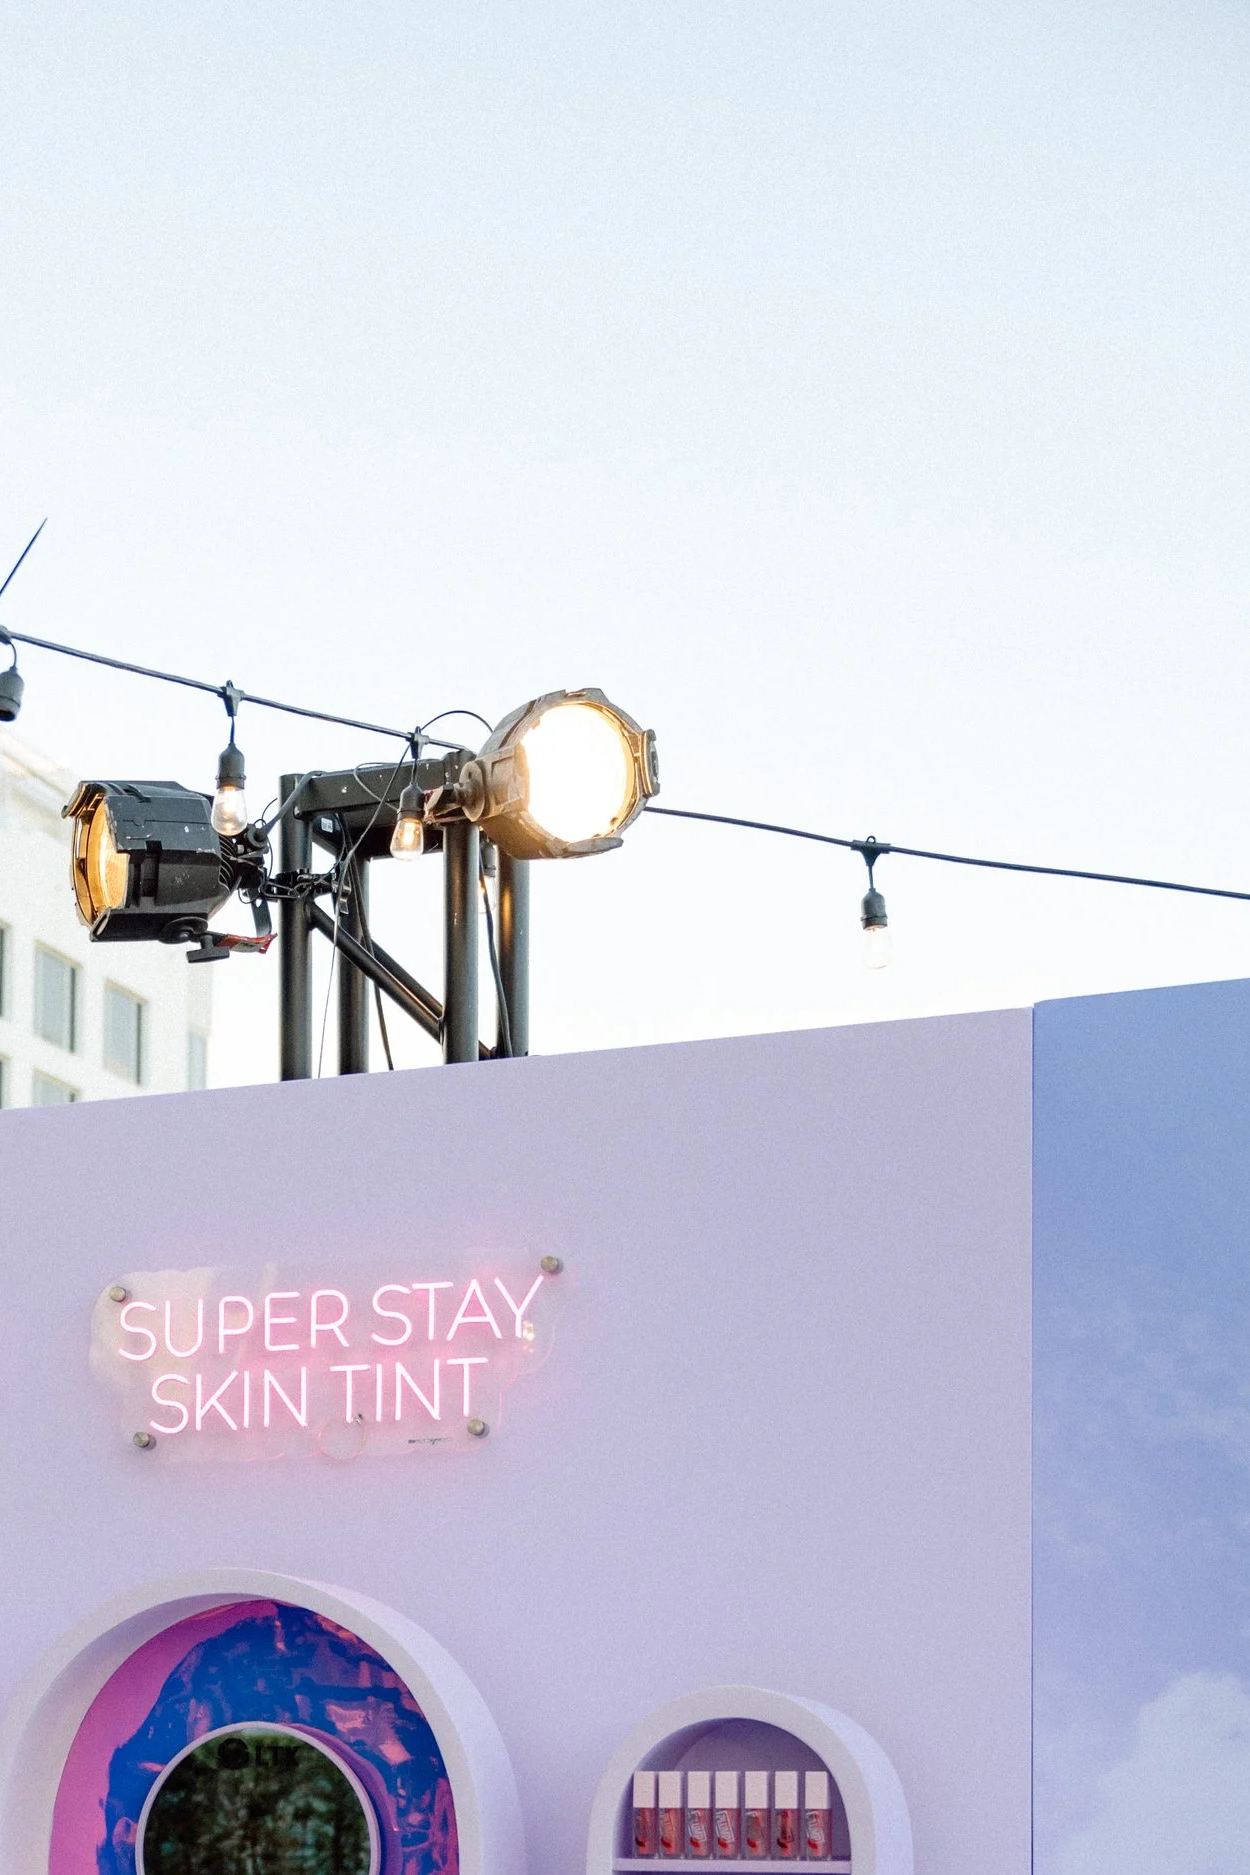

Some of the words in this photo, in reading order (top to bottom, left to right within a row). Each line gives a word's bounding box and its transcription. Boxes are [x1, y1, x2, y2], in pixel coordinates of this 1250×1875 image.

[118, 1289, 350, 1362] SUPER
[371, 1274, 544, 1346] STAY
[149, 1366, 308, 1434] SKIN
[330, 1357, 489, 1424] TINT
